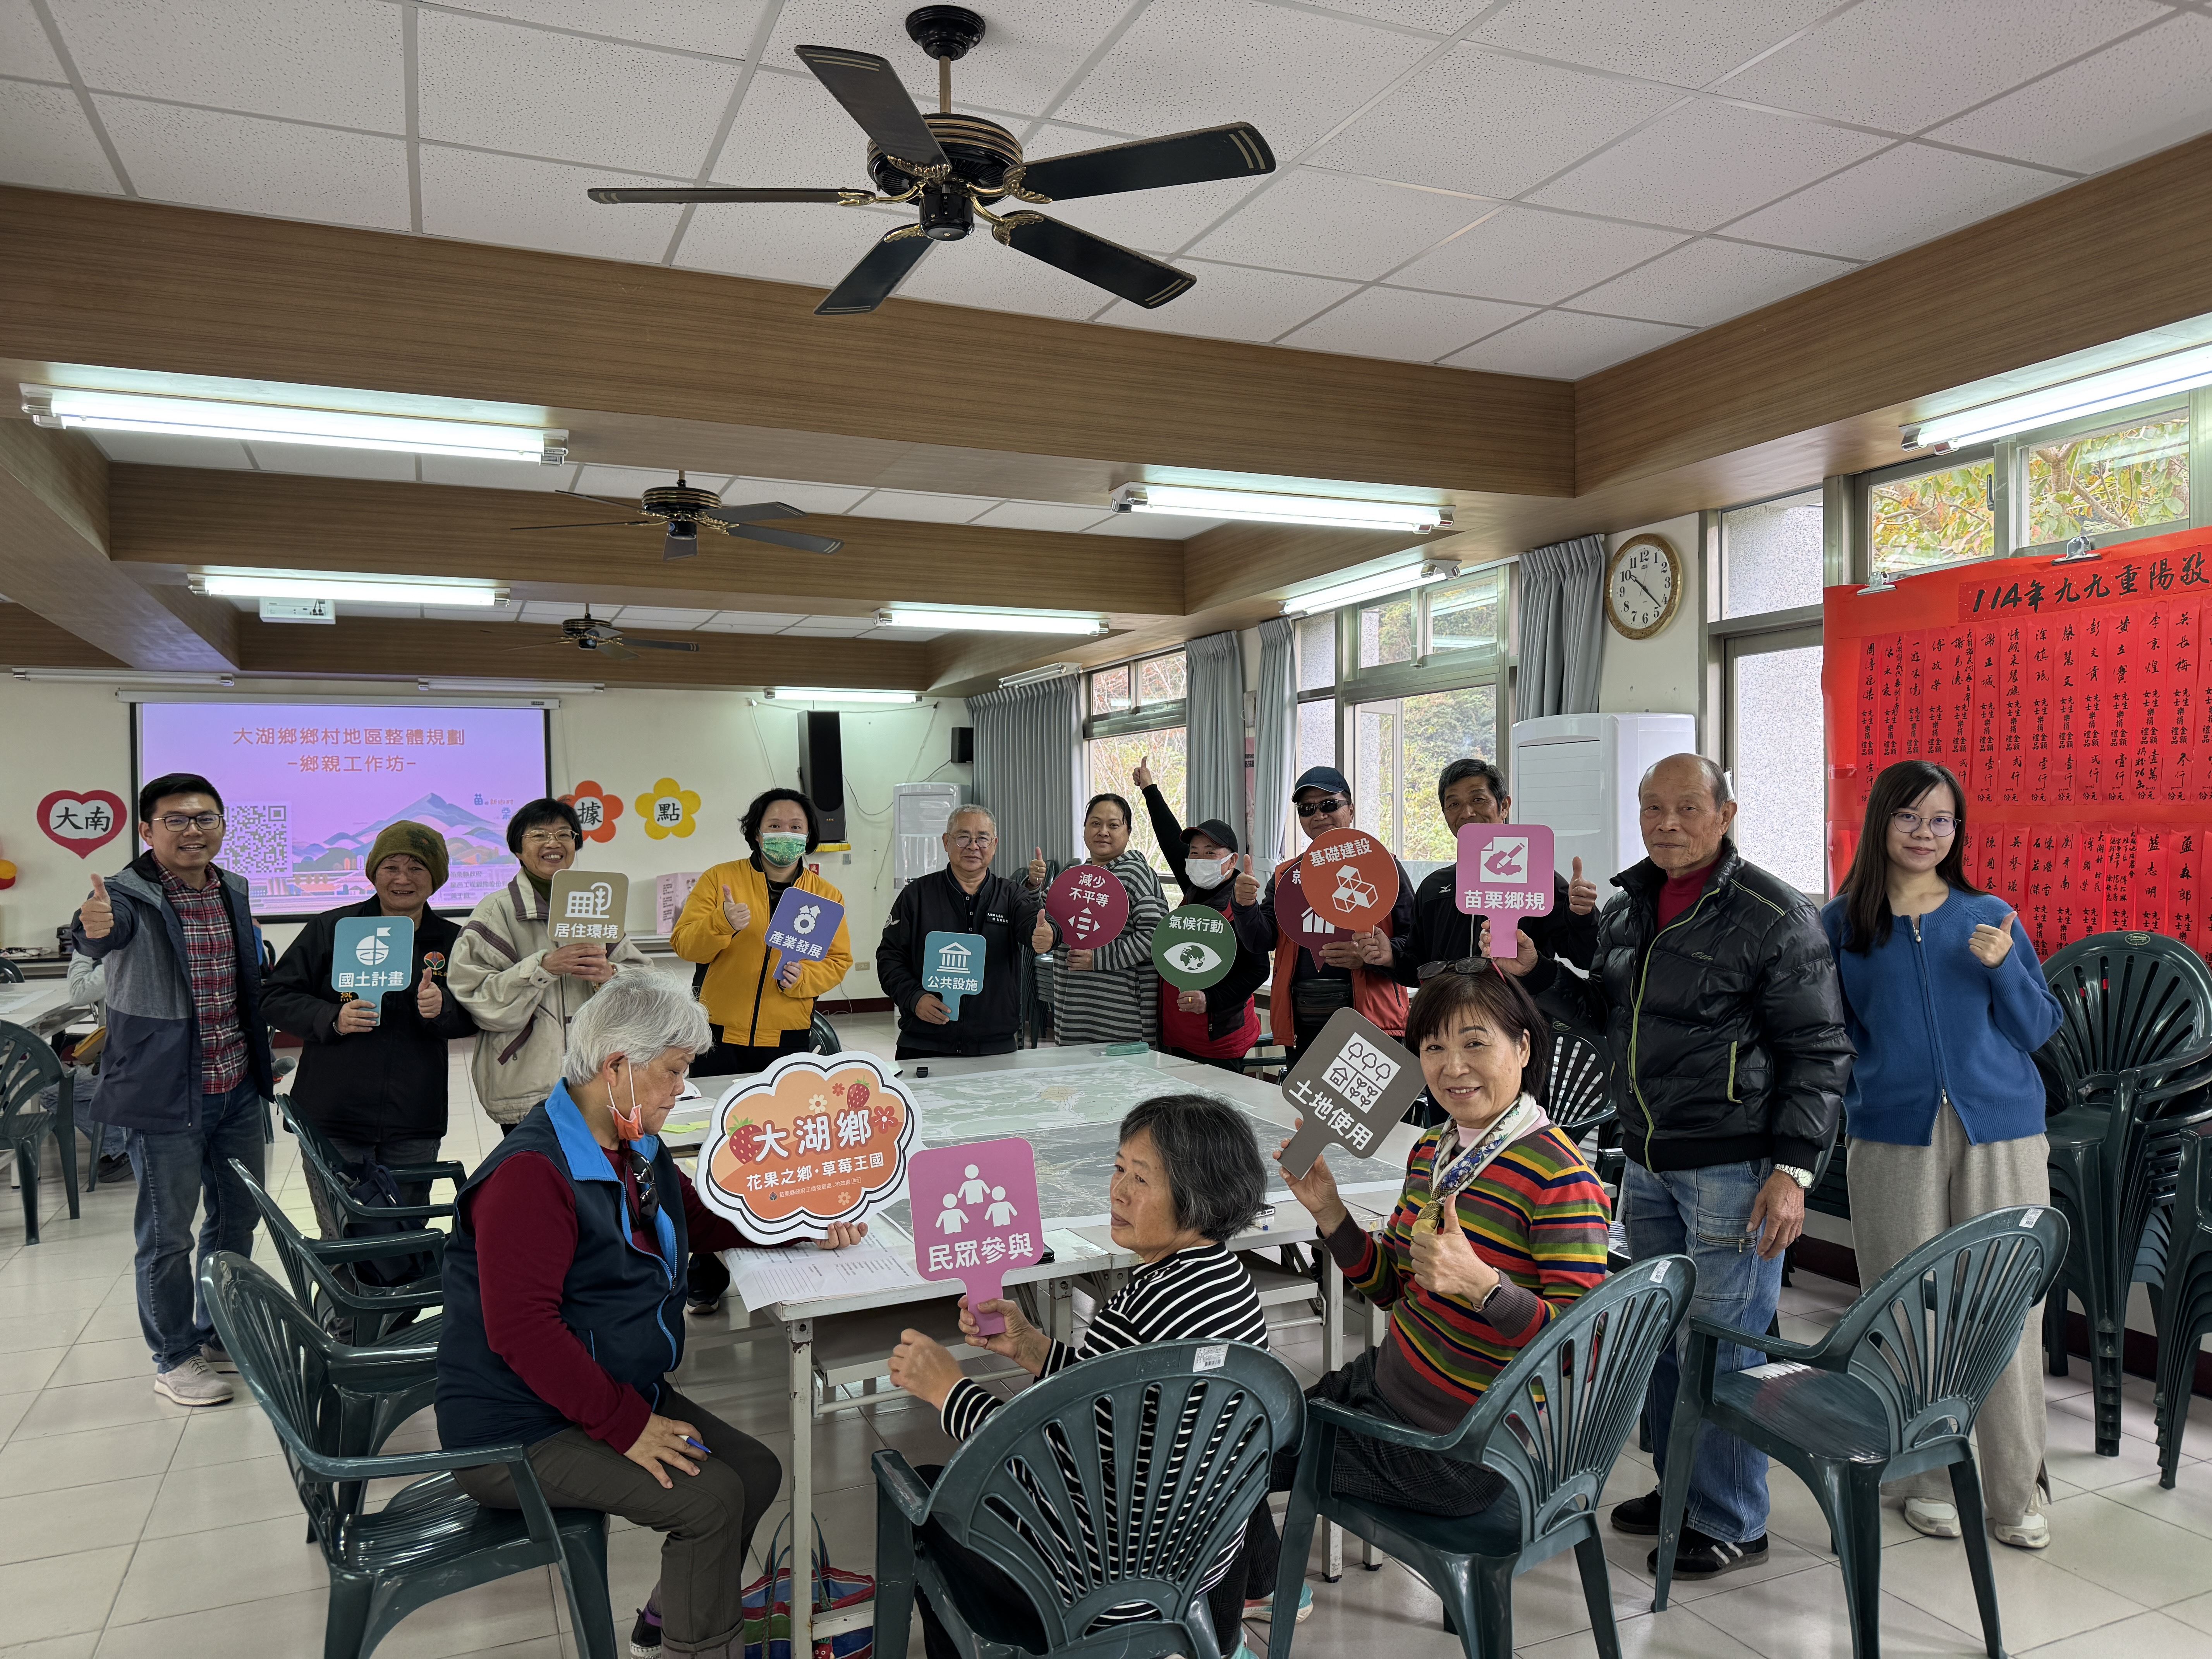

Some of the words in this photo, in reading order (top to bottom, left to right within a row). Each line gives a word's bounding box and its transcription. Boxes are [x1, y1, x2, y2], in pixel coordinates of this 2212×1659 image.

[1630, 557, 1637, 568] 11
[1640, 550, 1649, 562] 12
[1654, 552, 1657, 563] 1
[1661, 562, 1668, 573] 2
[1620, 570, 1631, 582] 10
[1664, 577, 1671, 588] 3
[1973, 551, 2210, 613] 114年九九重陽敬
[1620, 586, 1625, 597] 9
[1661, 594, 1668, 605] 4
[1624, 601, 1629, 612] 8
[1654, 607, 1659, 618] 5
[1632, 611, 1637, 622] 7
[1642, 612, 1648, 623] 6
[233, 727, 464, 745] 大湖鄉鄉村地區整體規劃
[287, 755, 416, 772] -鄉親工作坊-
[53, 806, 110, 832] 大南
[577, 801, 602, 826] 據
[658, 803, 679, 821] 點
[1309, 838, 1372, 867] 基礎建設
[1079, 872, 1105, 888] 減少
[1070, 888, 1109, 907] 不平等
[1464, 890, 1545, 910] 苗栗鄉規
[555, 923, 618, 939] 居住環境
[1169, 915, 1223, 933] 氣候行動
[769, 930, 823, 958] 產業發展
[339, 971, 404, 988] 國土計畫
[928, 976, 977, 991] 公共設施
[1288, 1080, 1374, 1151] 土地使用
[753, 1108, 872, 1162] 大湖鄉
[928, 1233, 1034, 1273] 民眾參與
